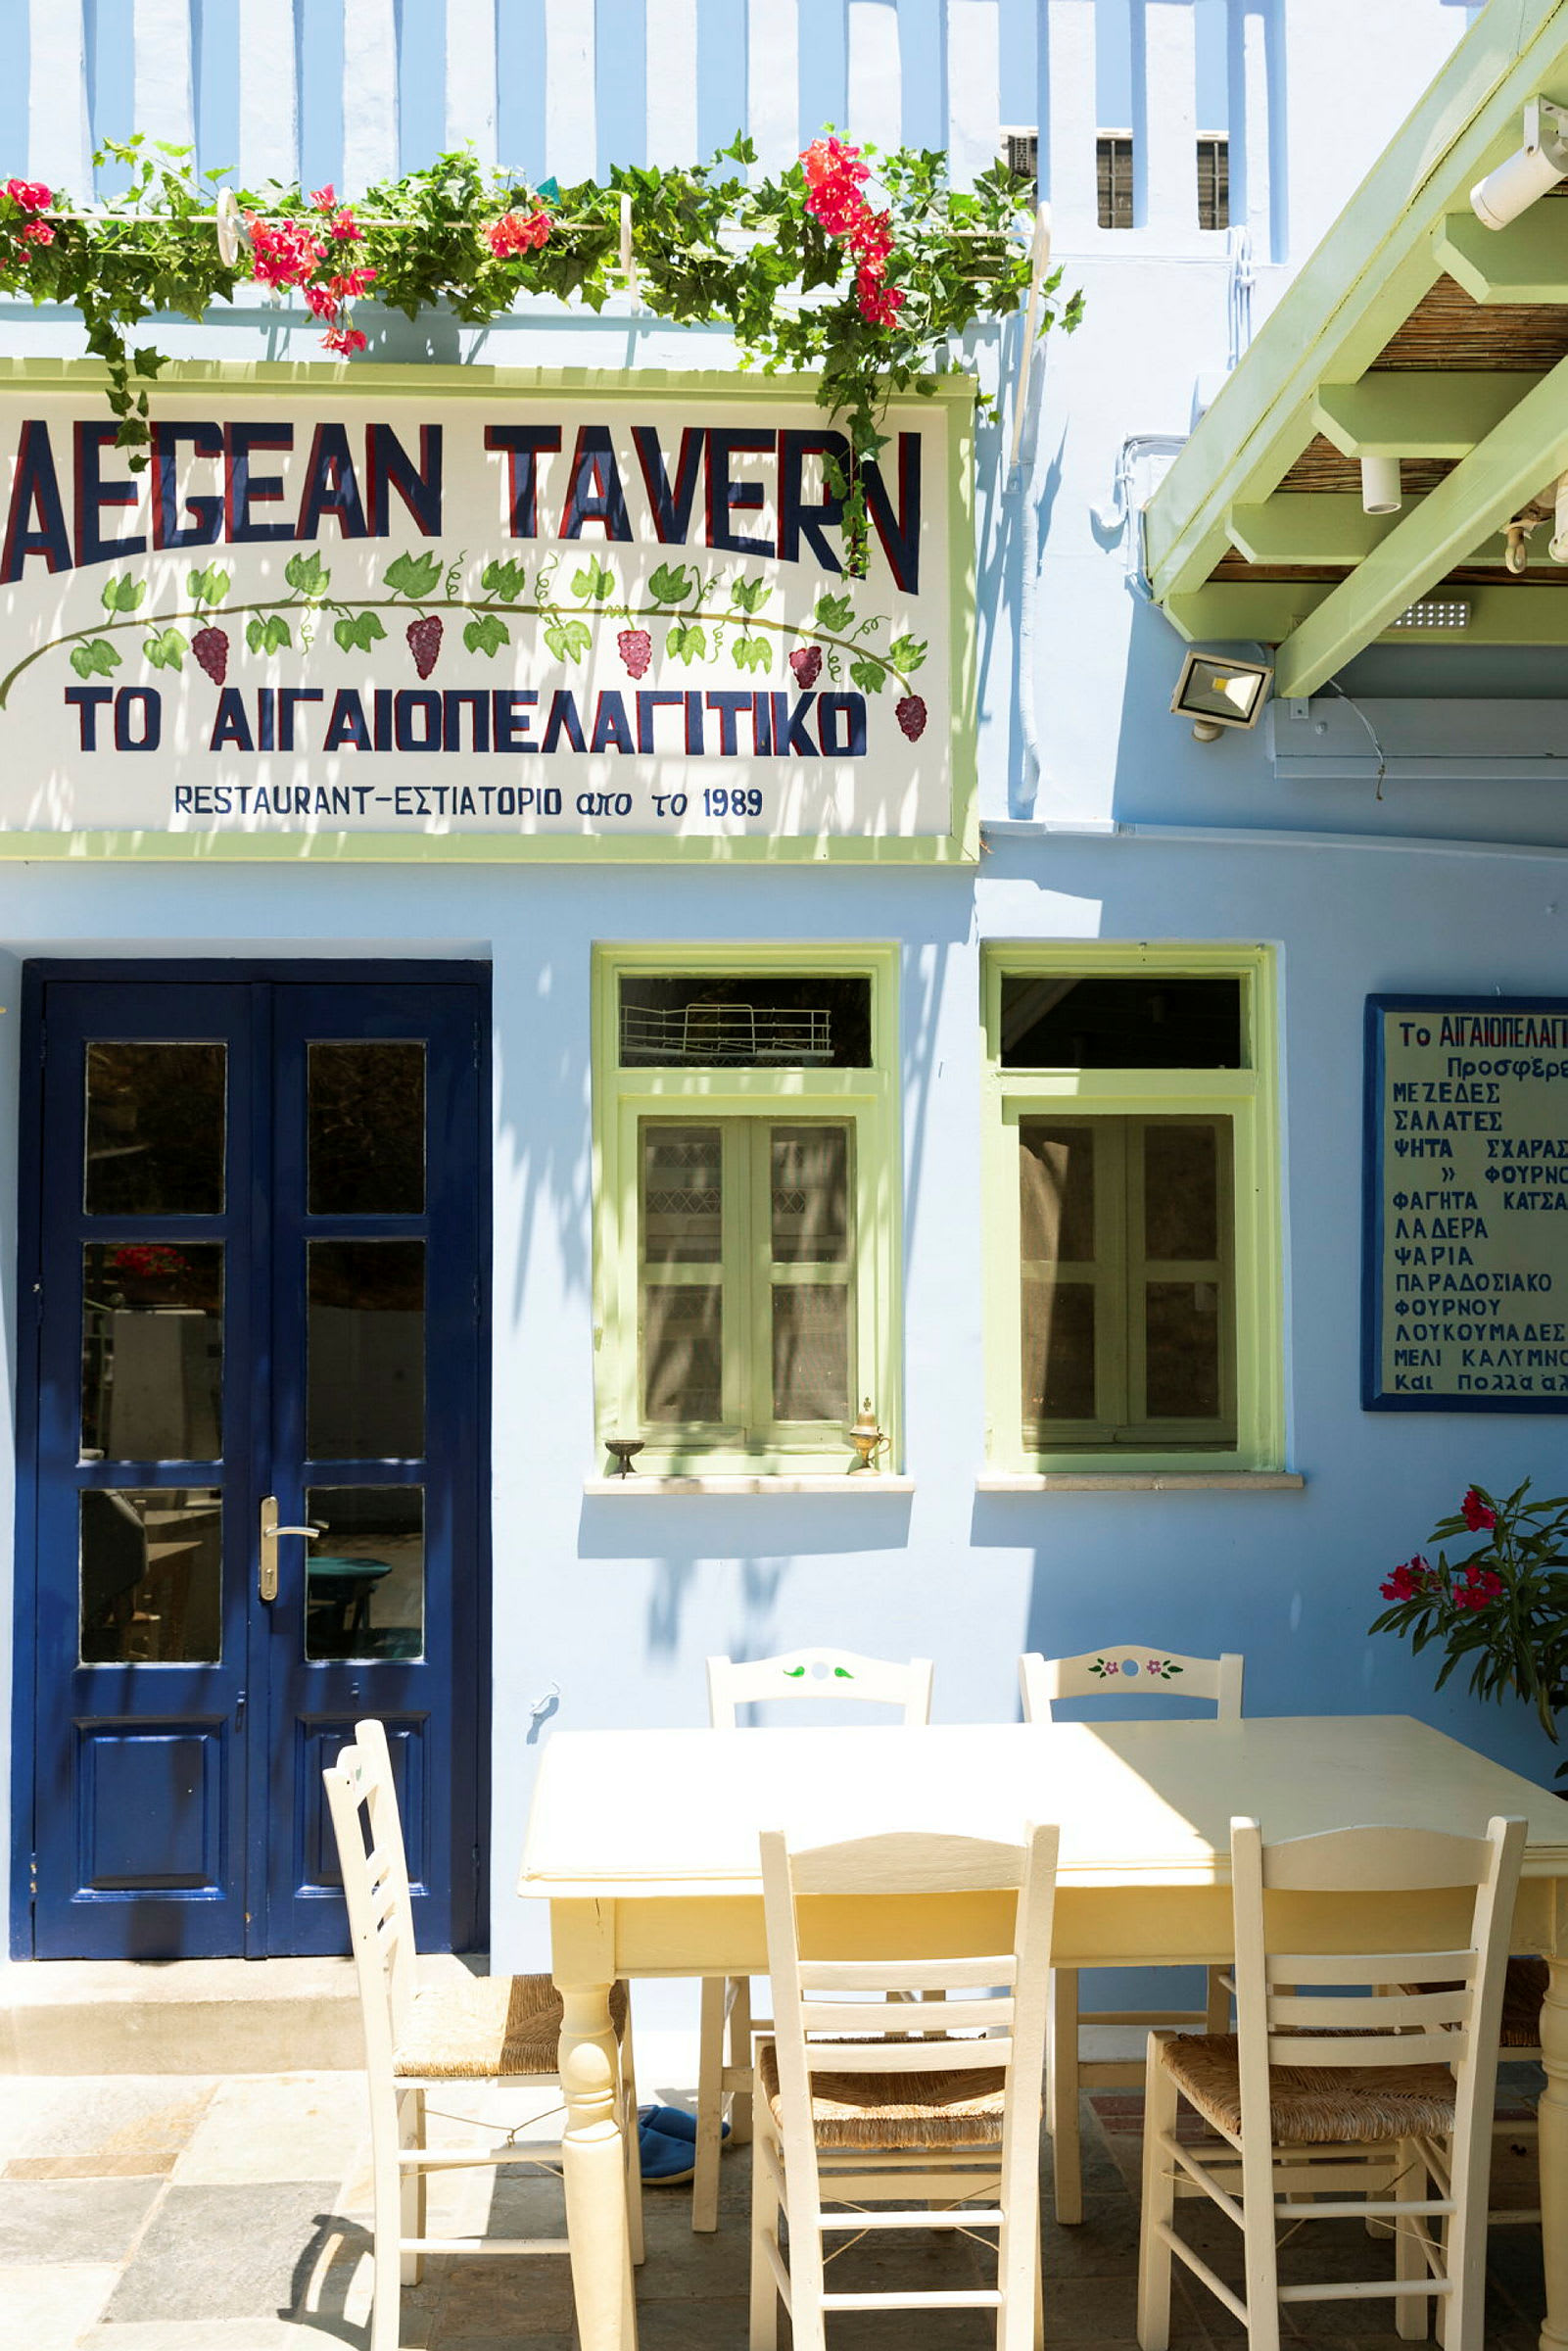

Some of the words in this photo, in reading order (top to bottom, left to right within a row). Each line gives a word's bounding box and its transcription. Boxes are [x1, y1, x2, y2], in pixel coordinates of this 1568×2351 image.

[0, 420, 443, 585] AEGEAN
[484, 424, 922, 596] TAVERN
[65, 687, 162, 752] ΤΟ
[209, 688, 867, 757] ΑΙΓΑΙΟΠΕΛΑΓΙΤΙΚΟ
[576, 792, 633, 816] απο
[651, 793, 688, 816] το
[703, 788, 764, 817] 1989
[1399, 1022, 1431, 1047] Το
[1393, 1081, 1500, 1104] ΜΕΖΕΔΕΣ
[1393, 1110, 1502, 1131] ΣΑΛΑΤΕΣ
[1394, 1138, 1453, 1158] ΨΗΤΑ
[1487, 1139, 1568, 1159] ΣΧΑΡΑΣ
[1392, 1191, 1479, 1211] ΦΑΓΗΤΑ
[1503, 1191, 1568, 1211] ΚΑΤΣΑ
[1395, 1218, 1489, 1239] ΛΑΔΕΡΑ
[1394, 1246, 1474, 1266] ΨΑΡΙΑ
[1396, 1273, 1552, 1292] ΠΑΡΑΔΟΣΙΑΚΟ
[1395, 1299, 1500, 1317] ΦΟΥΡΝΟΥ
[1396, 1323, 1565, 1342] ΛΟΥΚΟΥΜΑΔΕΣ
[1394, 1349, 1442, 1367] ΜΕΛΙ
